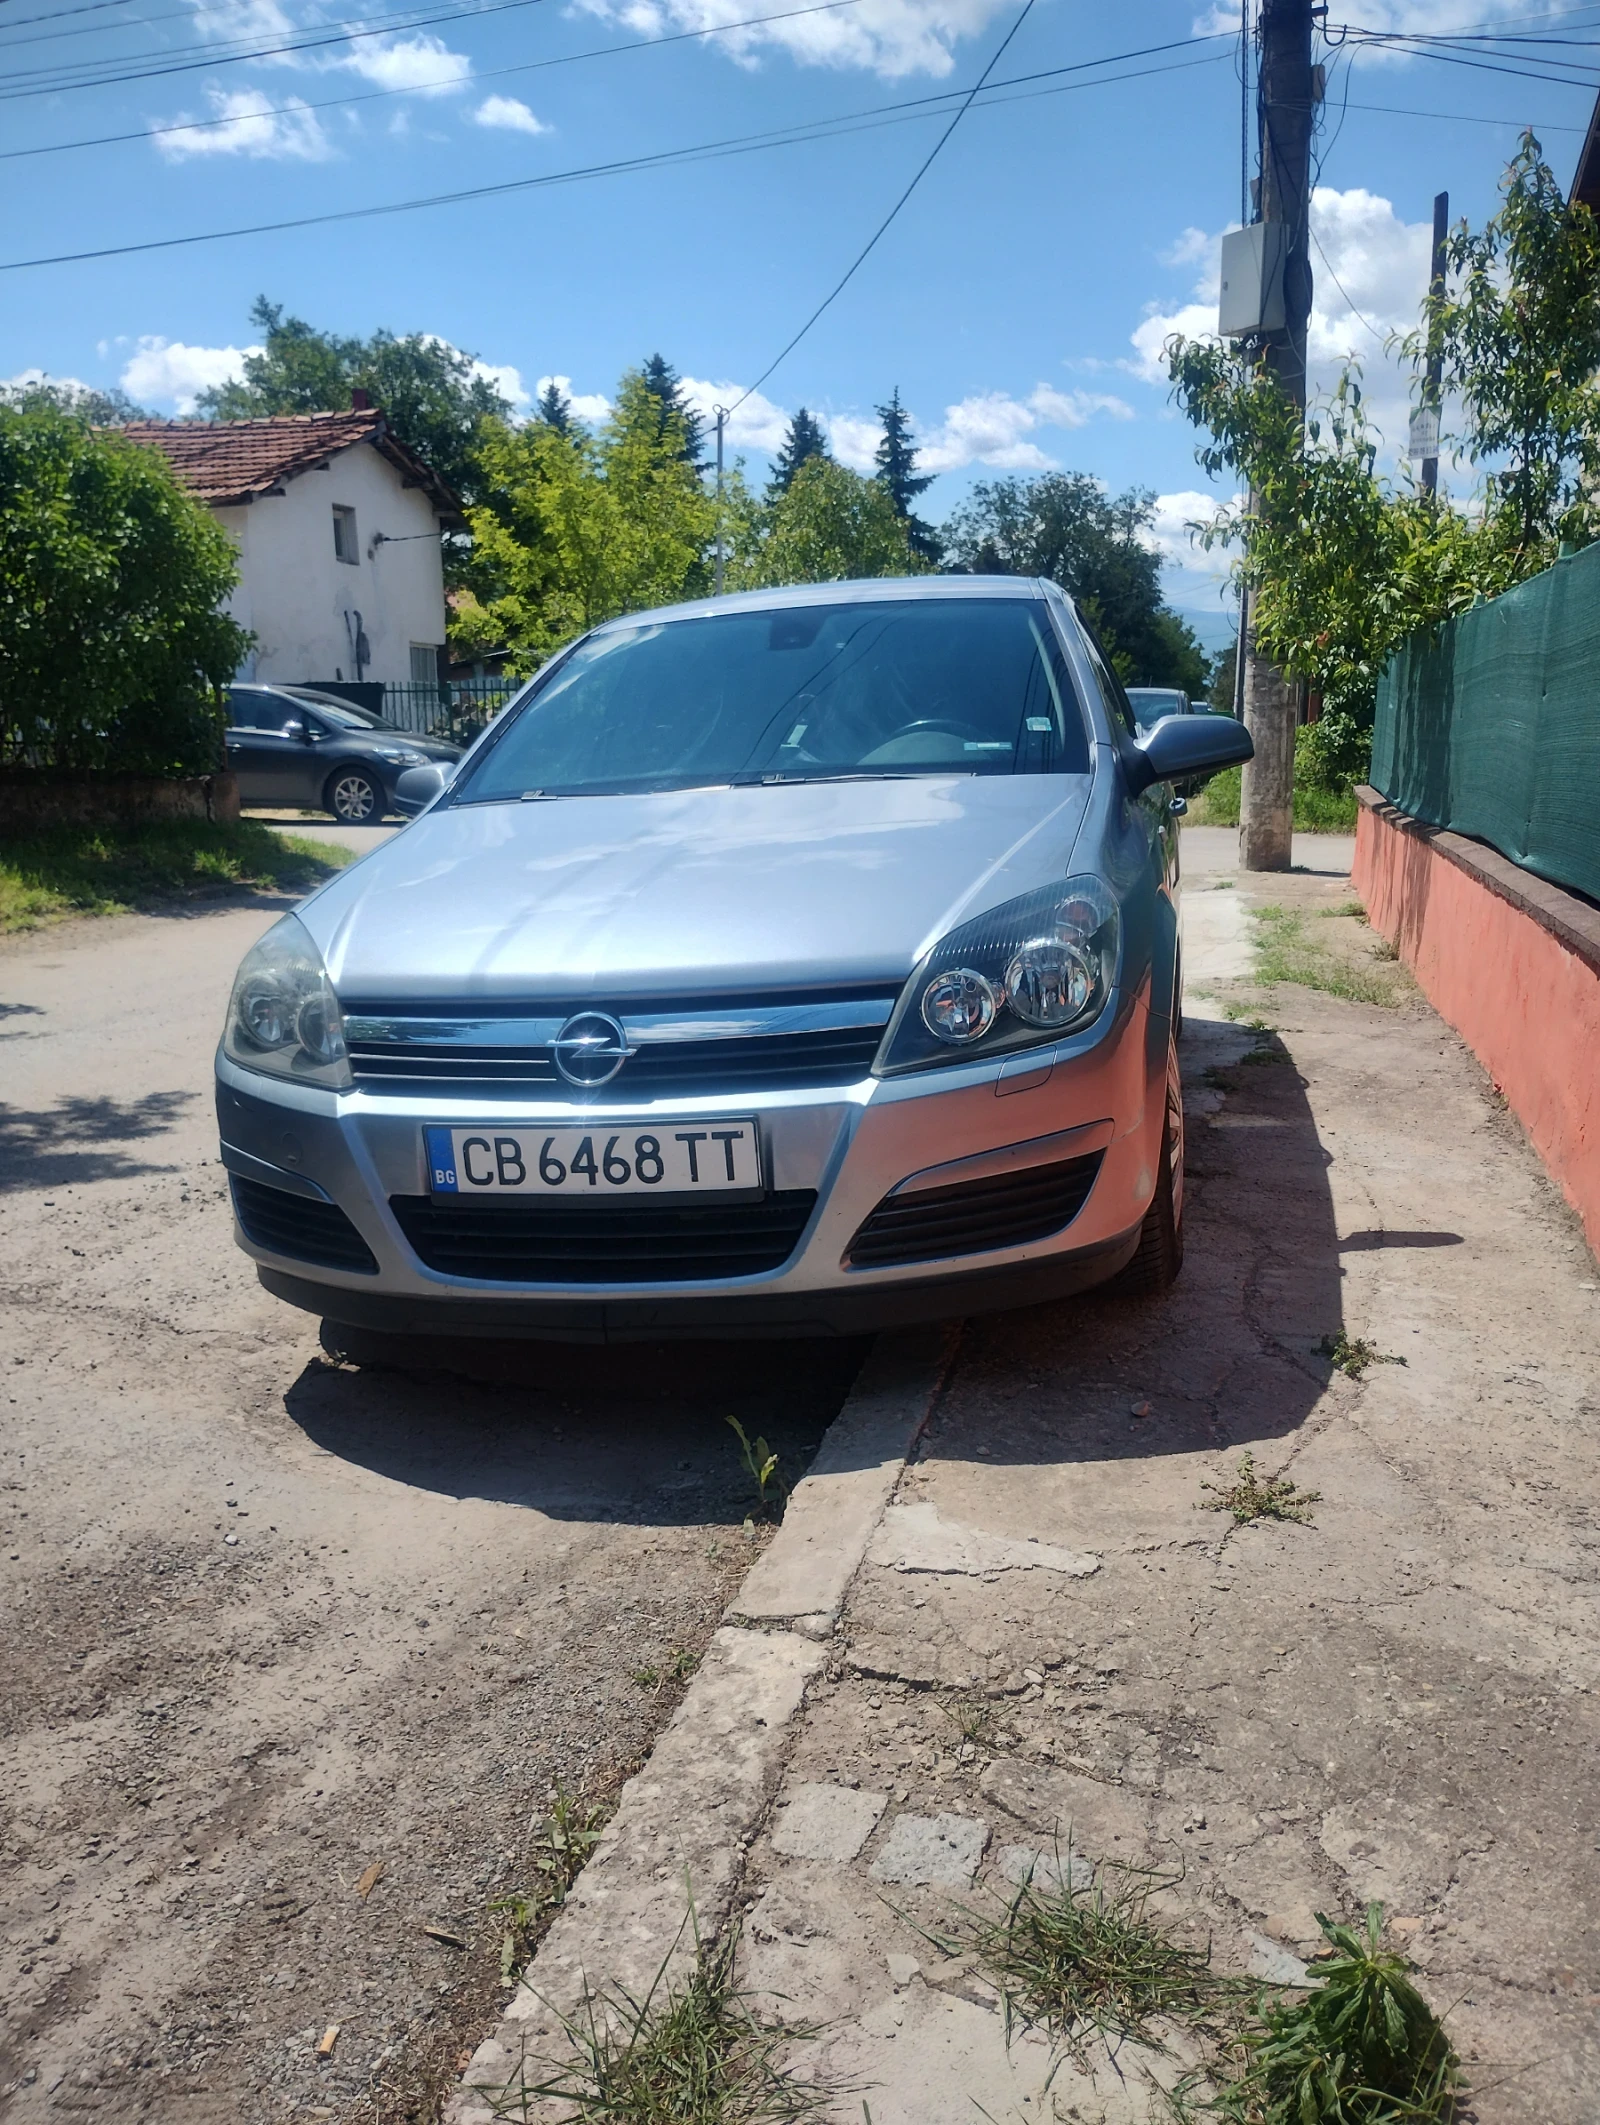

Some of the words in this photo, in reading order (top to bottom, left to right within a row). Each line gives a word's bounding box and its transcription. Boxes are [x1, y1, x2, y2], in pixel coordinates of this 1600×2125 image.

[462, 1136, 527, 1186] CB
[539, 1135, 665, 1186] 6468
[675, 1130, 744, 1183] TT
[435, 1169, 456, 1185] BG
